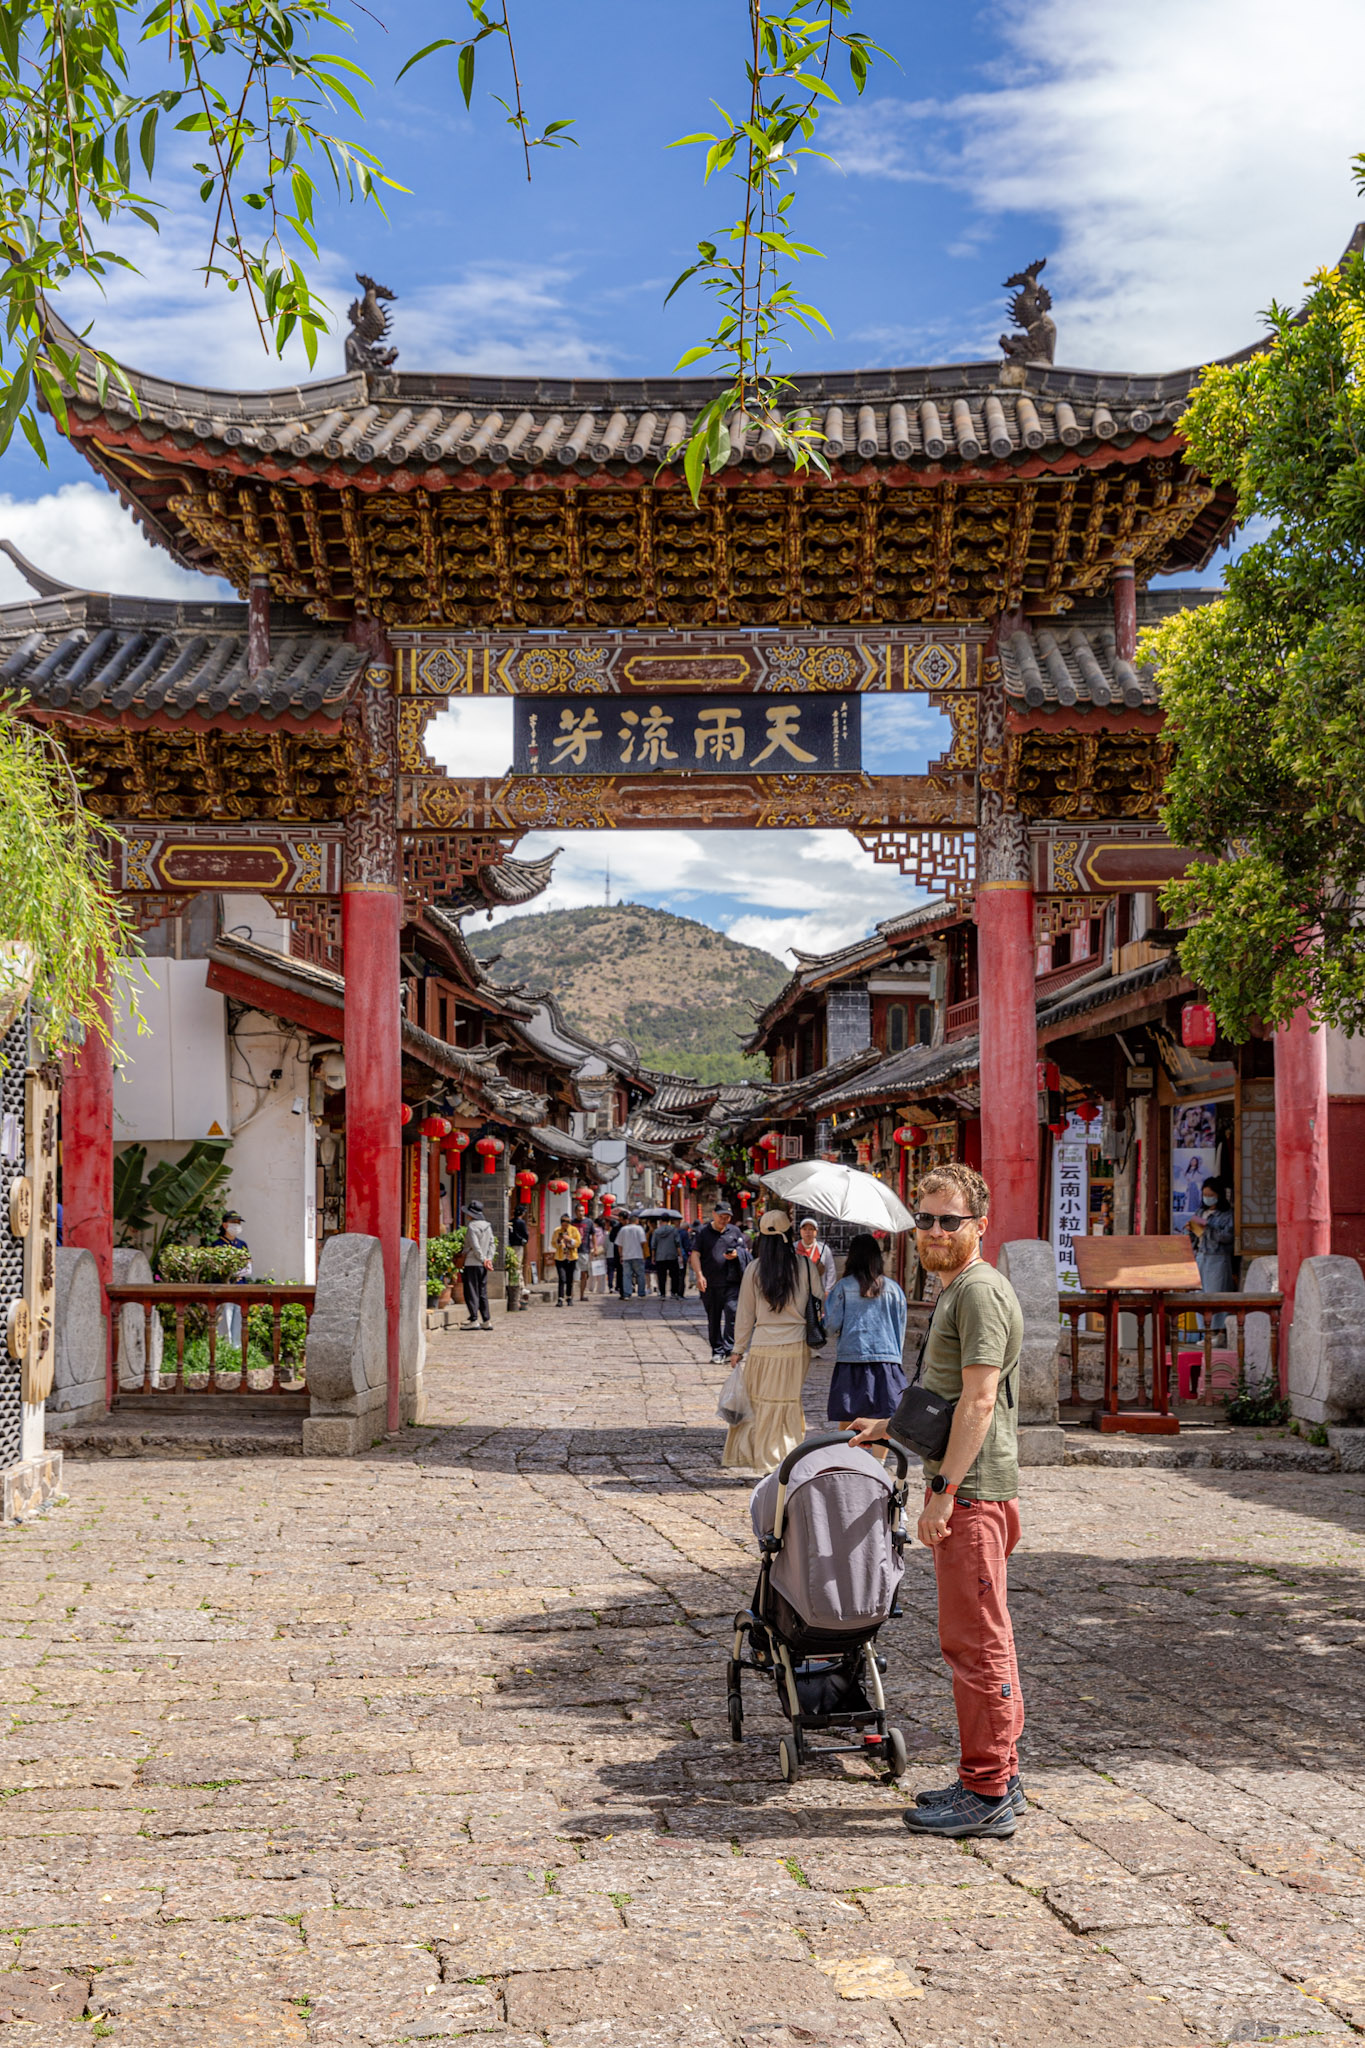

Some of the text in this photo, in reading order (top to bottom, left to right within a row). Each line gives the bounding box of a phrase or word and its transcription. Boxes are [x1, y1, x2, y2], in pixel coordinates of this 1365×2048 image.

[549, 704, 818, 767] 天雨流芳
[1058, 1165, 1081, 1327] 云南小粒咖啡专
